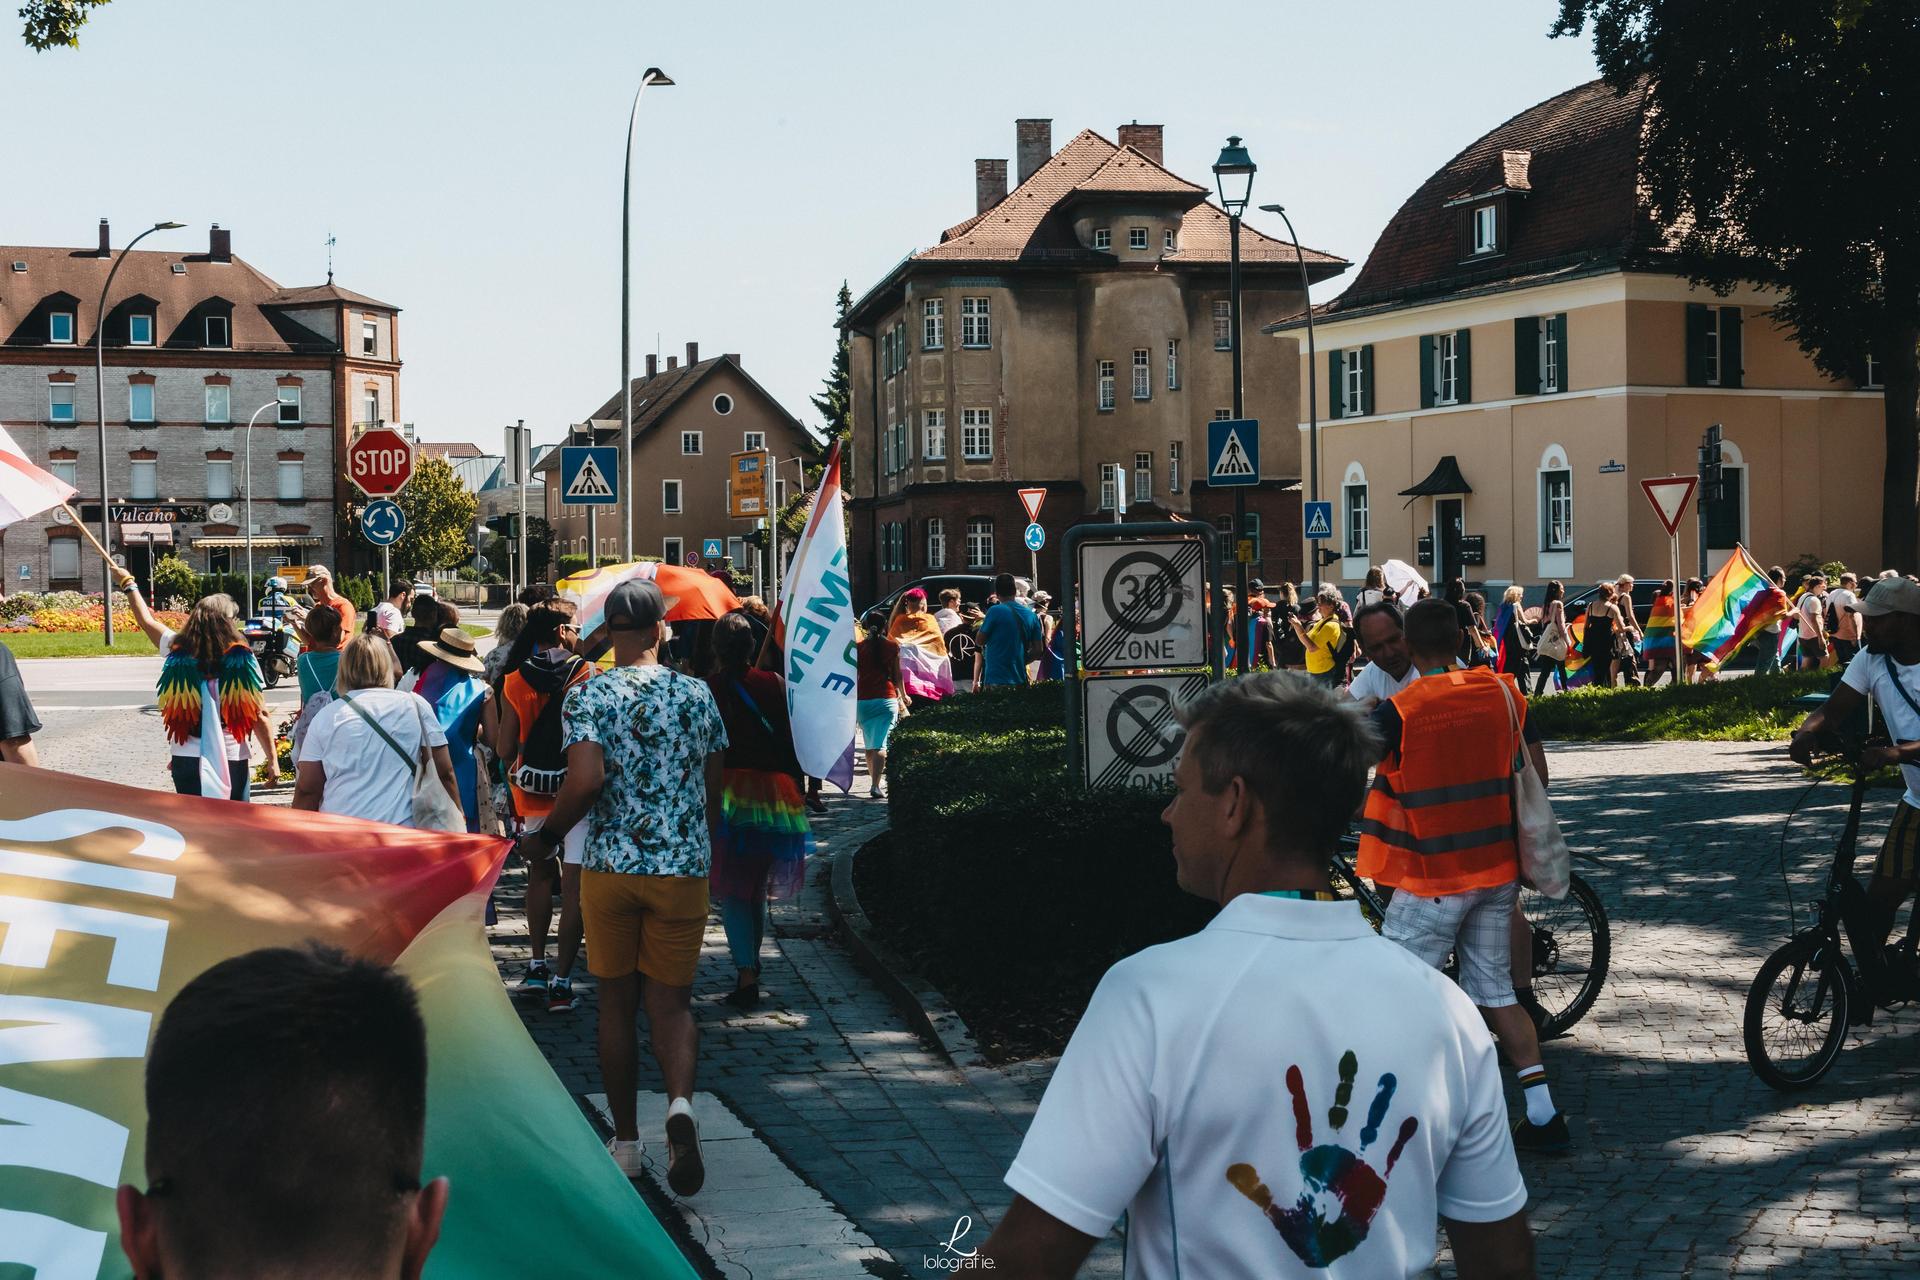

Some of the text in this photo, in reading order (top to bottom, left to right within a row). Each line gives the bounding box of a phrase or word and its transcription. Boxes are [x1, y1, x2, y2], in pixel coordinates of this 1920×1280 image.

[354, 449, 406, 476] STOP
[111, 507, 173, 522] Vulcano
[1119, 574, 1167, 611] 30
[1114, 639, 1176, 661] ZONE
